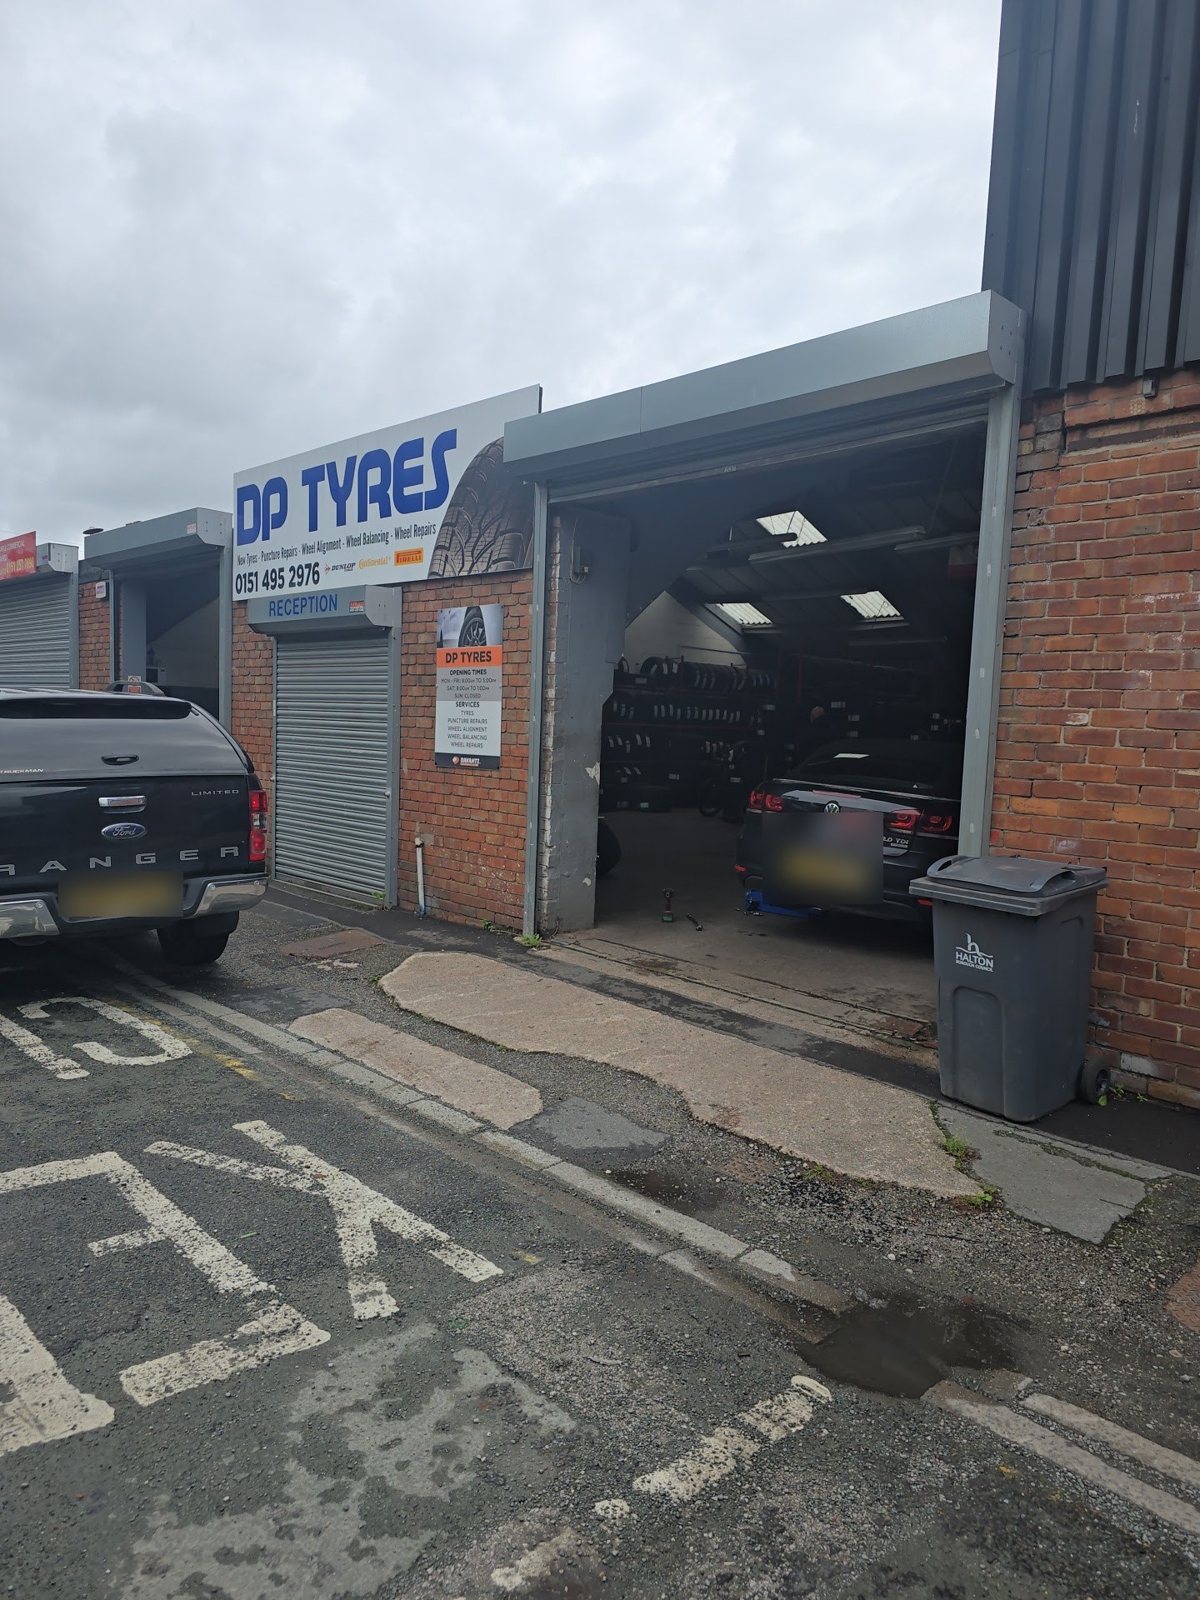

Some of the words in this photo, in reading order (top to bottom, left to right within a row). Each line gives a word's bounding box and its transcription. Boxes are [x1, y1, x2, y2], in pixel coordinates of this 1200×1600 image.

[236, 476, 288, 546] DP
[301, 428, 457, 532] TYRES
[237, 555, 246, 566] New
[246, 553, 258, 566] Tyres
[261, 550, 280, 562] Puncture
[281, 546, 298, 560] Repairs
[301, 541, 316, 555] Wheel
[317, 538, 342, 555] Alignment
[346, 533, 361, 548] Wheel
[363, 530, 389, 545] Balancing
[394, 525, 412, 540] Wheel
[413, 521, 437, 539] Repairs
[235, 570, 259, 594] 0151
[262, 567, 285, 591] 495
[288, 561, 320, 588] 2976
[331, 562, 356, 571] DUNLOP
[269, 594, 338, 617] RECEPTION
[445, 652, 458, 663] DP
[460, 651, 492, 663] TYRES
[0, 846, 239, 876] RANGER
[955, 951, 994, 969] HALTON
